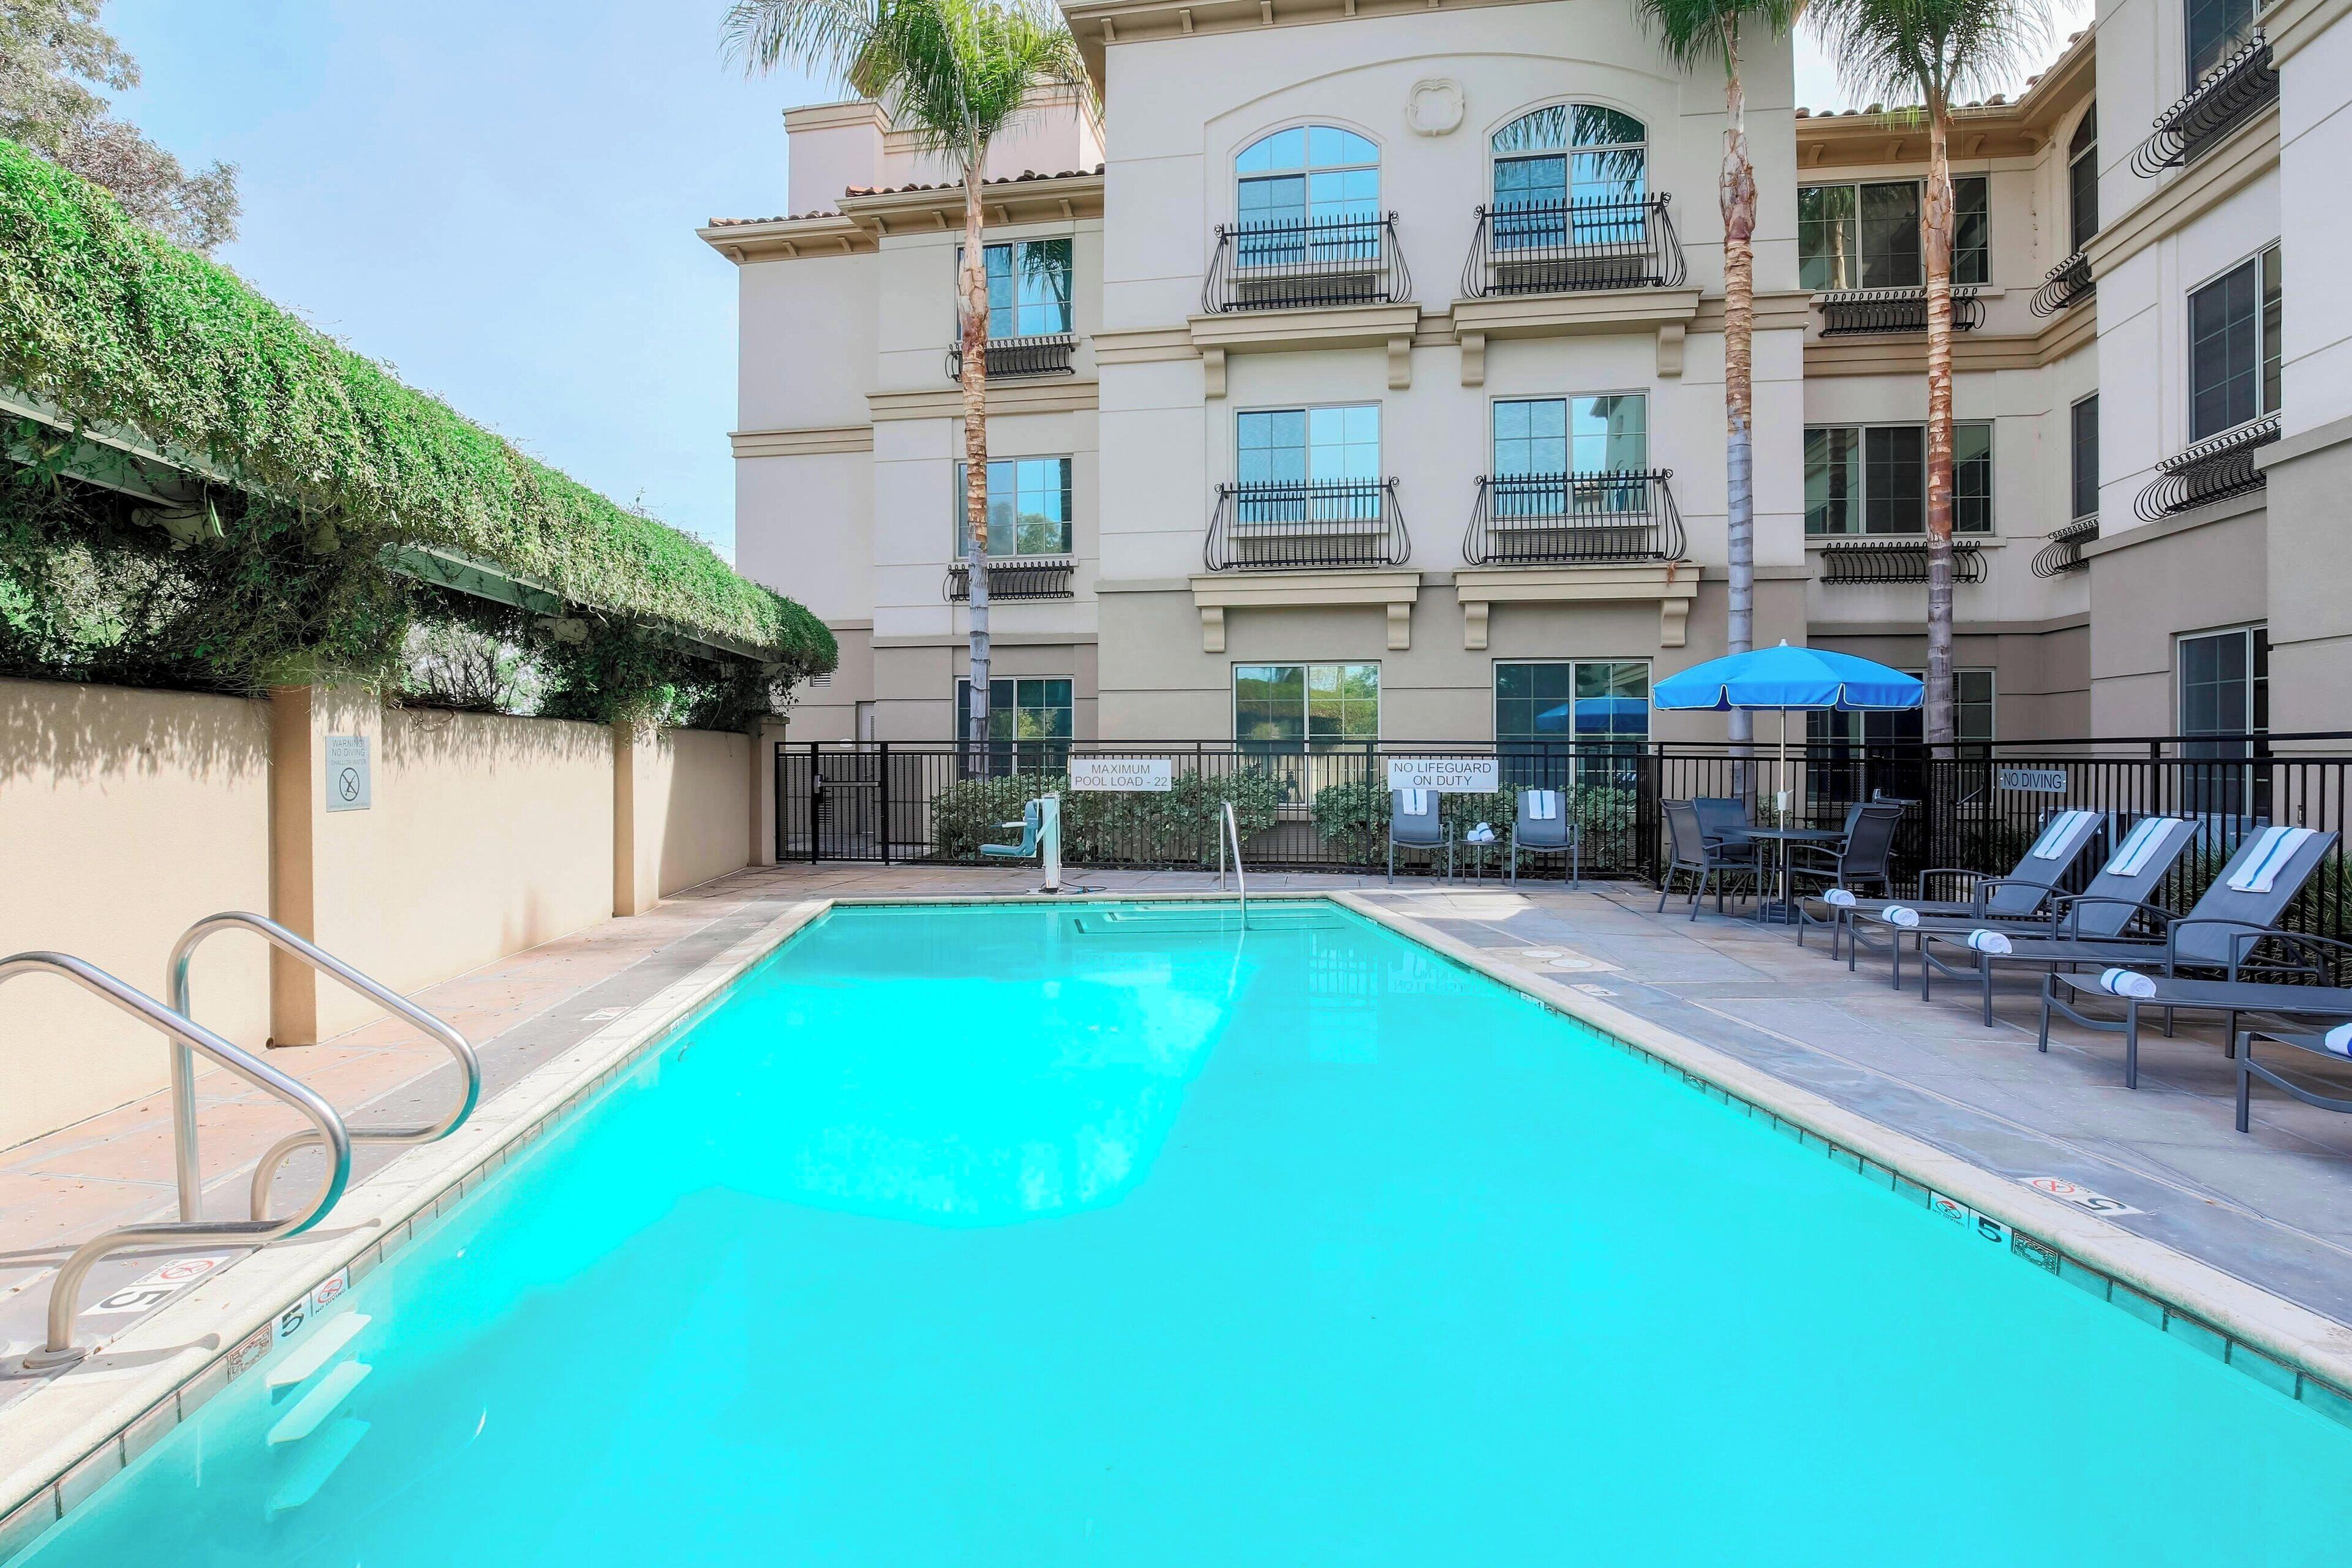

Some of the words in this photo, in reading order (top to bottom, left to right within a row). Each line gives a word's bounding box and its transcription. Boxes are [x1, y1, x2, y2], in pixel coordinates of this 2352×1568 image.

[344, 748, 365, 756] DIVING
[1091, 764, 1150, 774] MAXIMUM
[1394, 763, 1413, 772] NO
[1417, 763, 1491, 773] LIFEGUARD
[1075, 776, 1107, 786] POOL
[1111, 776, 1143, 786] LOAD
[1154, 777, 1167, 786] 22
[1413, 775, 1431, 785] ON
[1437, 775, 1472, 786] DUTY
[2003, 772, 2019, 786] NO
[2021, 773, 2062, 789] DIVING
[2072, 1198, 2127, 1210] 5
[1943, 1213, 1965, 1227] DIVING
[1977, 1216, 2002, 1243] 5
[99, 1289, 174, 1308] 5
[315, 1305, 325, 1314] NO
[325, 1289, 346, 1306] DIVING
[281, 1303, 304, 1337] 5
